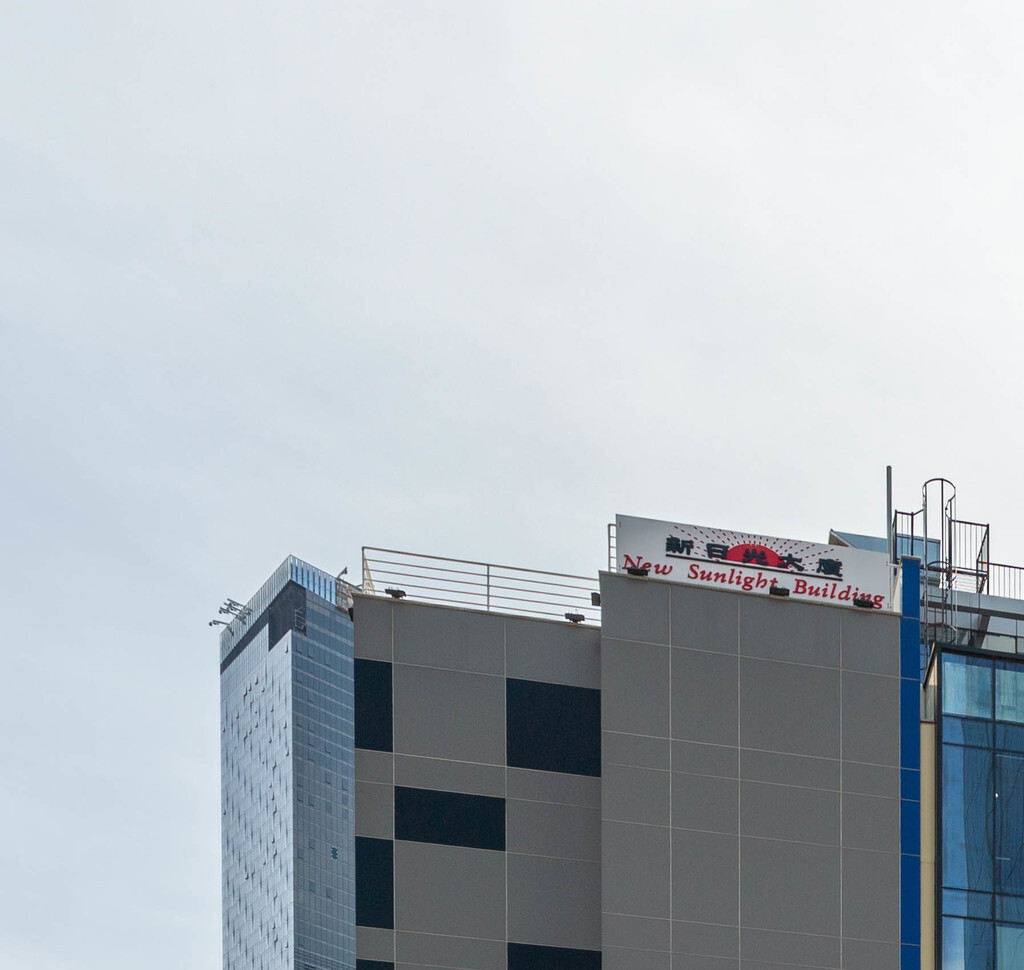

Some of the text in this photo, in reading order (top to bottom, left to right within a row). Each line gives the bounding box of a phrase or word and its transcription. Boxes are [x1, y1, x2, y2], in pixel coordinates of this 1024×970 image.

[622, 554, 885, 609] New Sunlight Building
